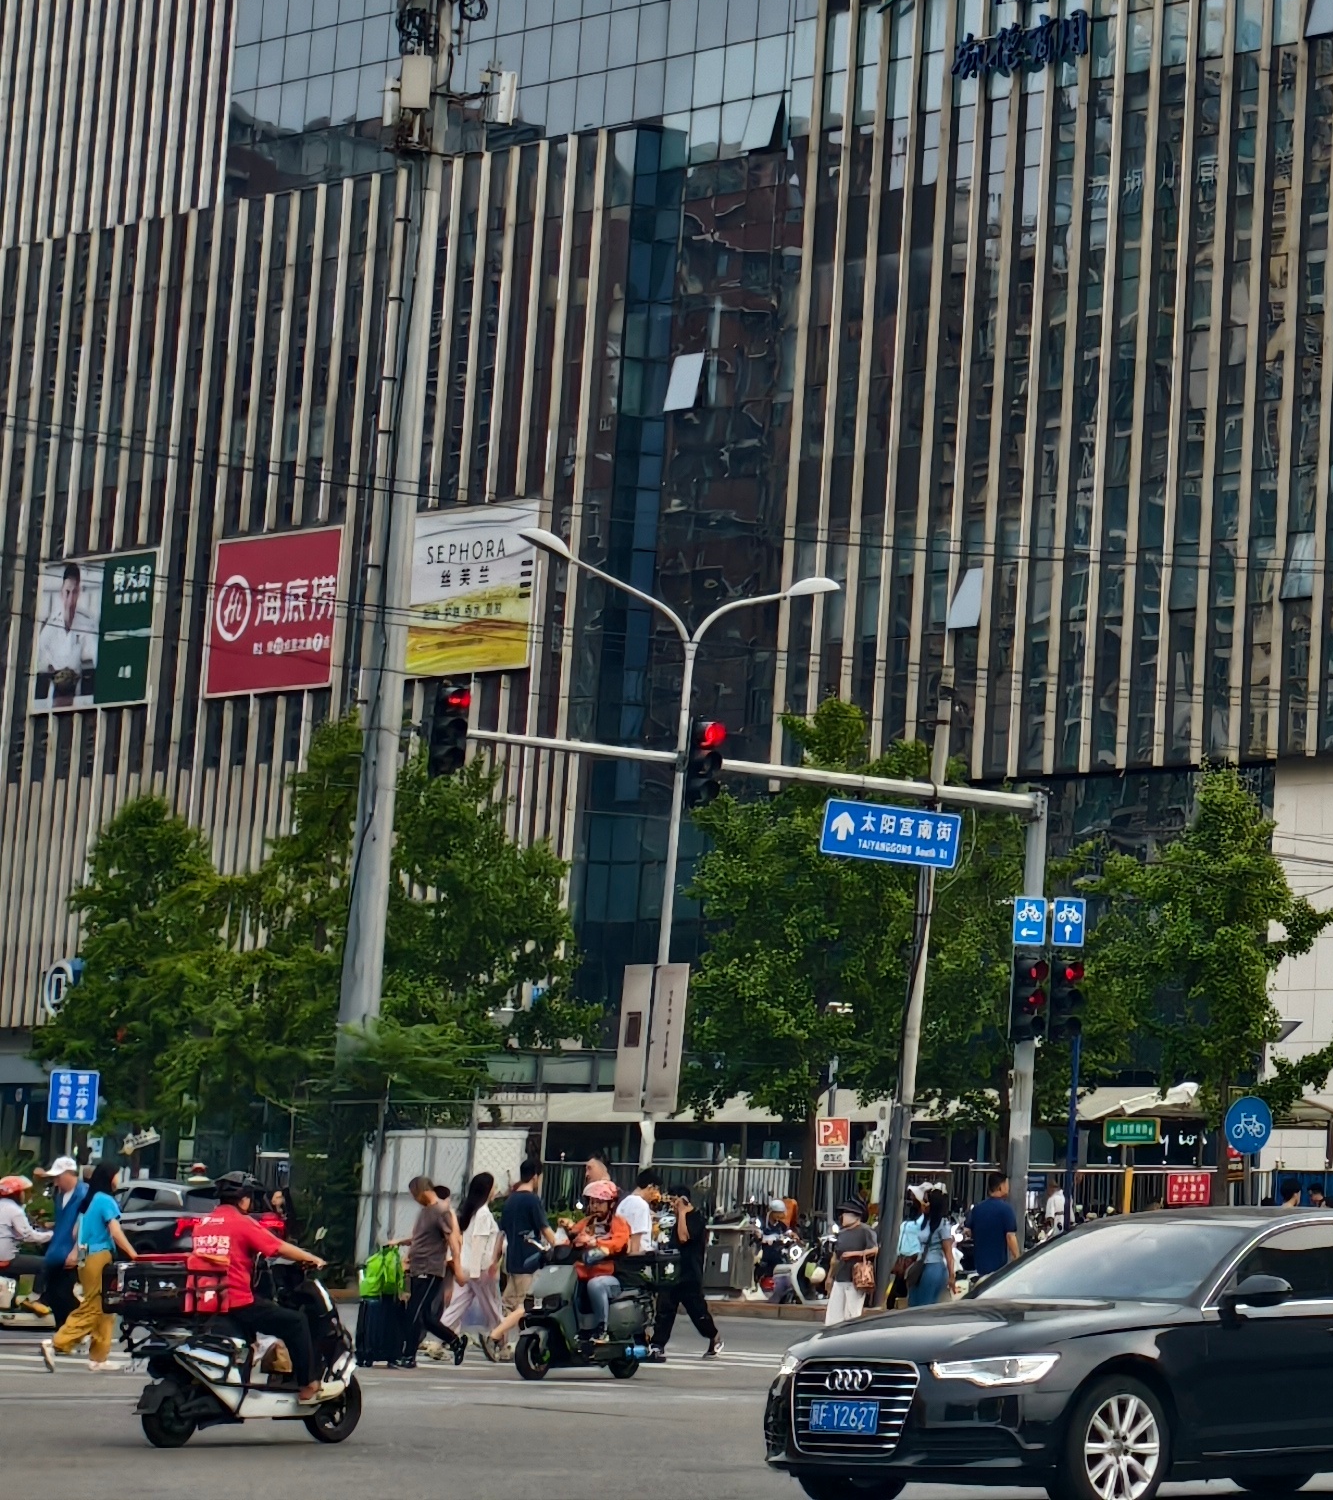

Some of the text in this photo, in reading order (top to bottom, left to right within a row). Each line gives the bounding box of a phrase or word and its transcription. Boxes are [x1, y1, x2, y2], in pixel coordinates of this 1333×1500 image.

[427, 538, 507, 564] SEPHORA
[440, 566, 490, 587] 丝芙兰
[254, 575, 337, 626] 海底捞
[860, 810, 952, 842] 太阳宫南街
[820, 1121, 834, 1145] P
